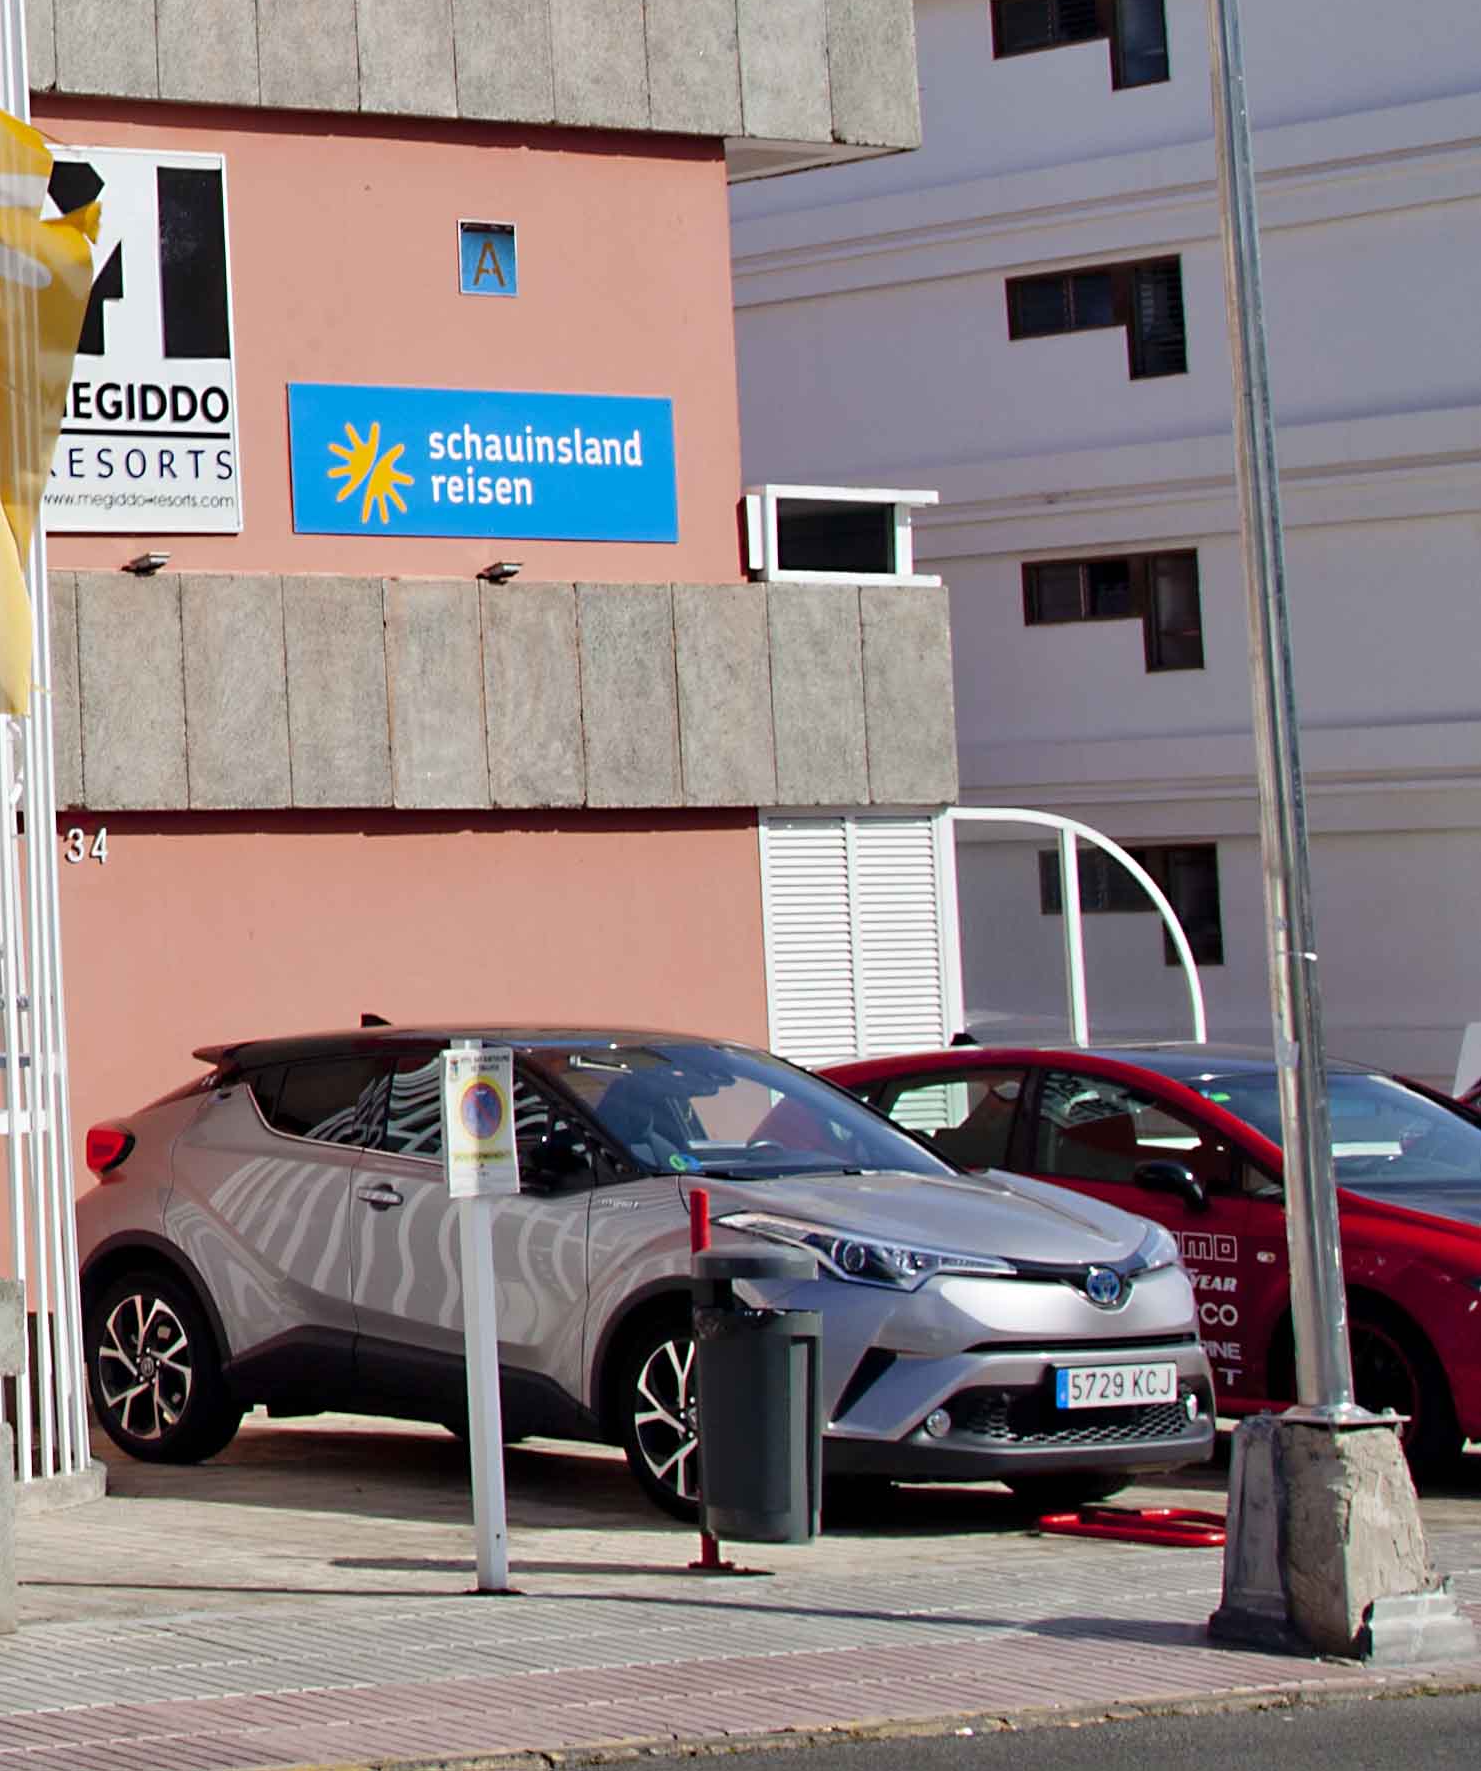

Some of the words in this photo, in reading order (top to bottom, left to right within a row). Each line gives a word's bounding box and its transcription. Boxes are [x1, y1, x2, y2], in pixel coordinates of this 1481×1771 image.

[473, 241, 506, 287] A
[62, 382, 230, 424] EGIDDO
[50, 447, 234, 480] ESORTS
[428, 423, 643, 468] schauinsland
[431, 465, 534, 506] reisen
[63, 827, 109, 865] 34
[1071, 1372, 1124, 1401] 5729
[1132, 1368, 1171, 1397] KCJ
